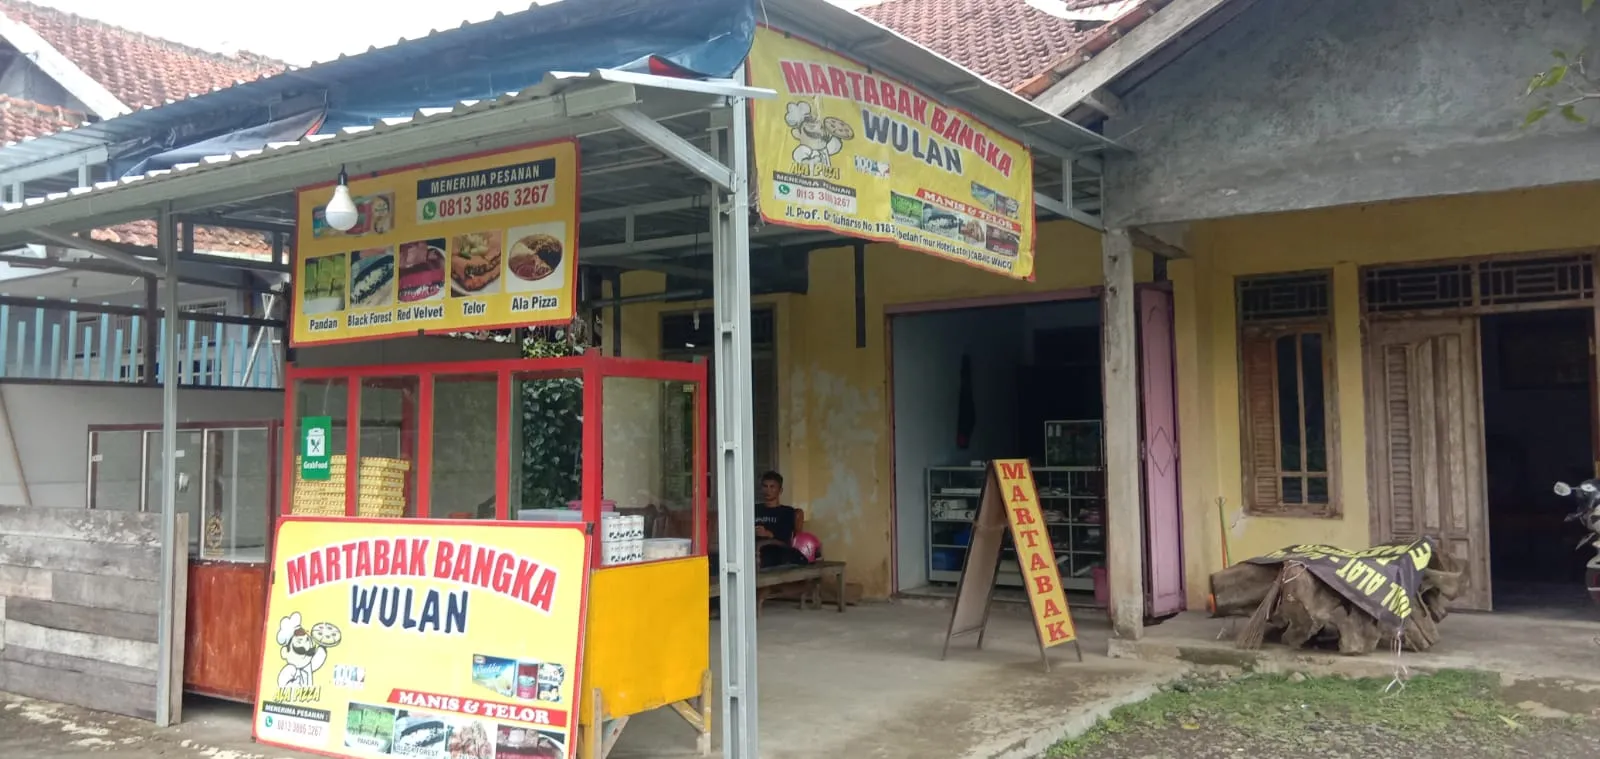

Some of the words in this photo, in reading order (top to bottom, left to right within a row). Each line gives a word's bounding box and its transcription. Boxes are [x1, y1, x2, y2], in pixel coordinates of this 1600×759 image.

[780, 60, 927, 125] MARTABAK
[930, 106, 1014, 178] BANGKA
[862, 109, 963, 174] WULAN
[430, 174, 487, 195] MENERIMA
[489, 164, 540, 185] PESANAN
[439, 196, 472, 218] 0813
[475, 191, 509, 213] 3886
[514, 184, 549, 206] 3267
[923, 191, 965, 211] MANIS
[397, 307, 411, 321] Red
[413, 305, 443, 320] Velvet
[463, 301, 486, 315] Telor
[511, 297, 529, 310] Ala
[532, 295, 557, 309] Pizza
[309, 317, 338, 331] Pandan
[347, 313, 368, 327] Black
[369, 310, 392, 326] Forest
[1000, 463, 1070, 642] MARTABAK
[286, 538, 430, 595] MARTABAK
[433, 541, 557, 613] BANGKA
[351, 584, 469, 634] WULAN
[265, 703, 295, 715] MENERIMA
[296, 709, 324, 720] PESANAN
[400, 690, 455, 711] MANIS
[461, 700, 480, 714] &
[482, 704, 549, 725] TELOR
